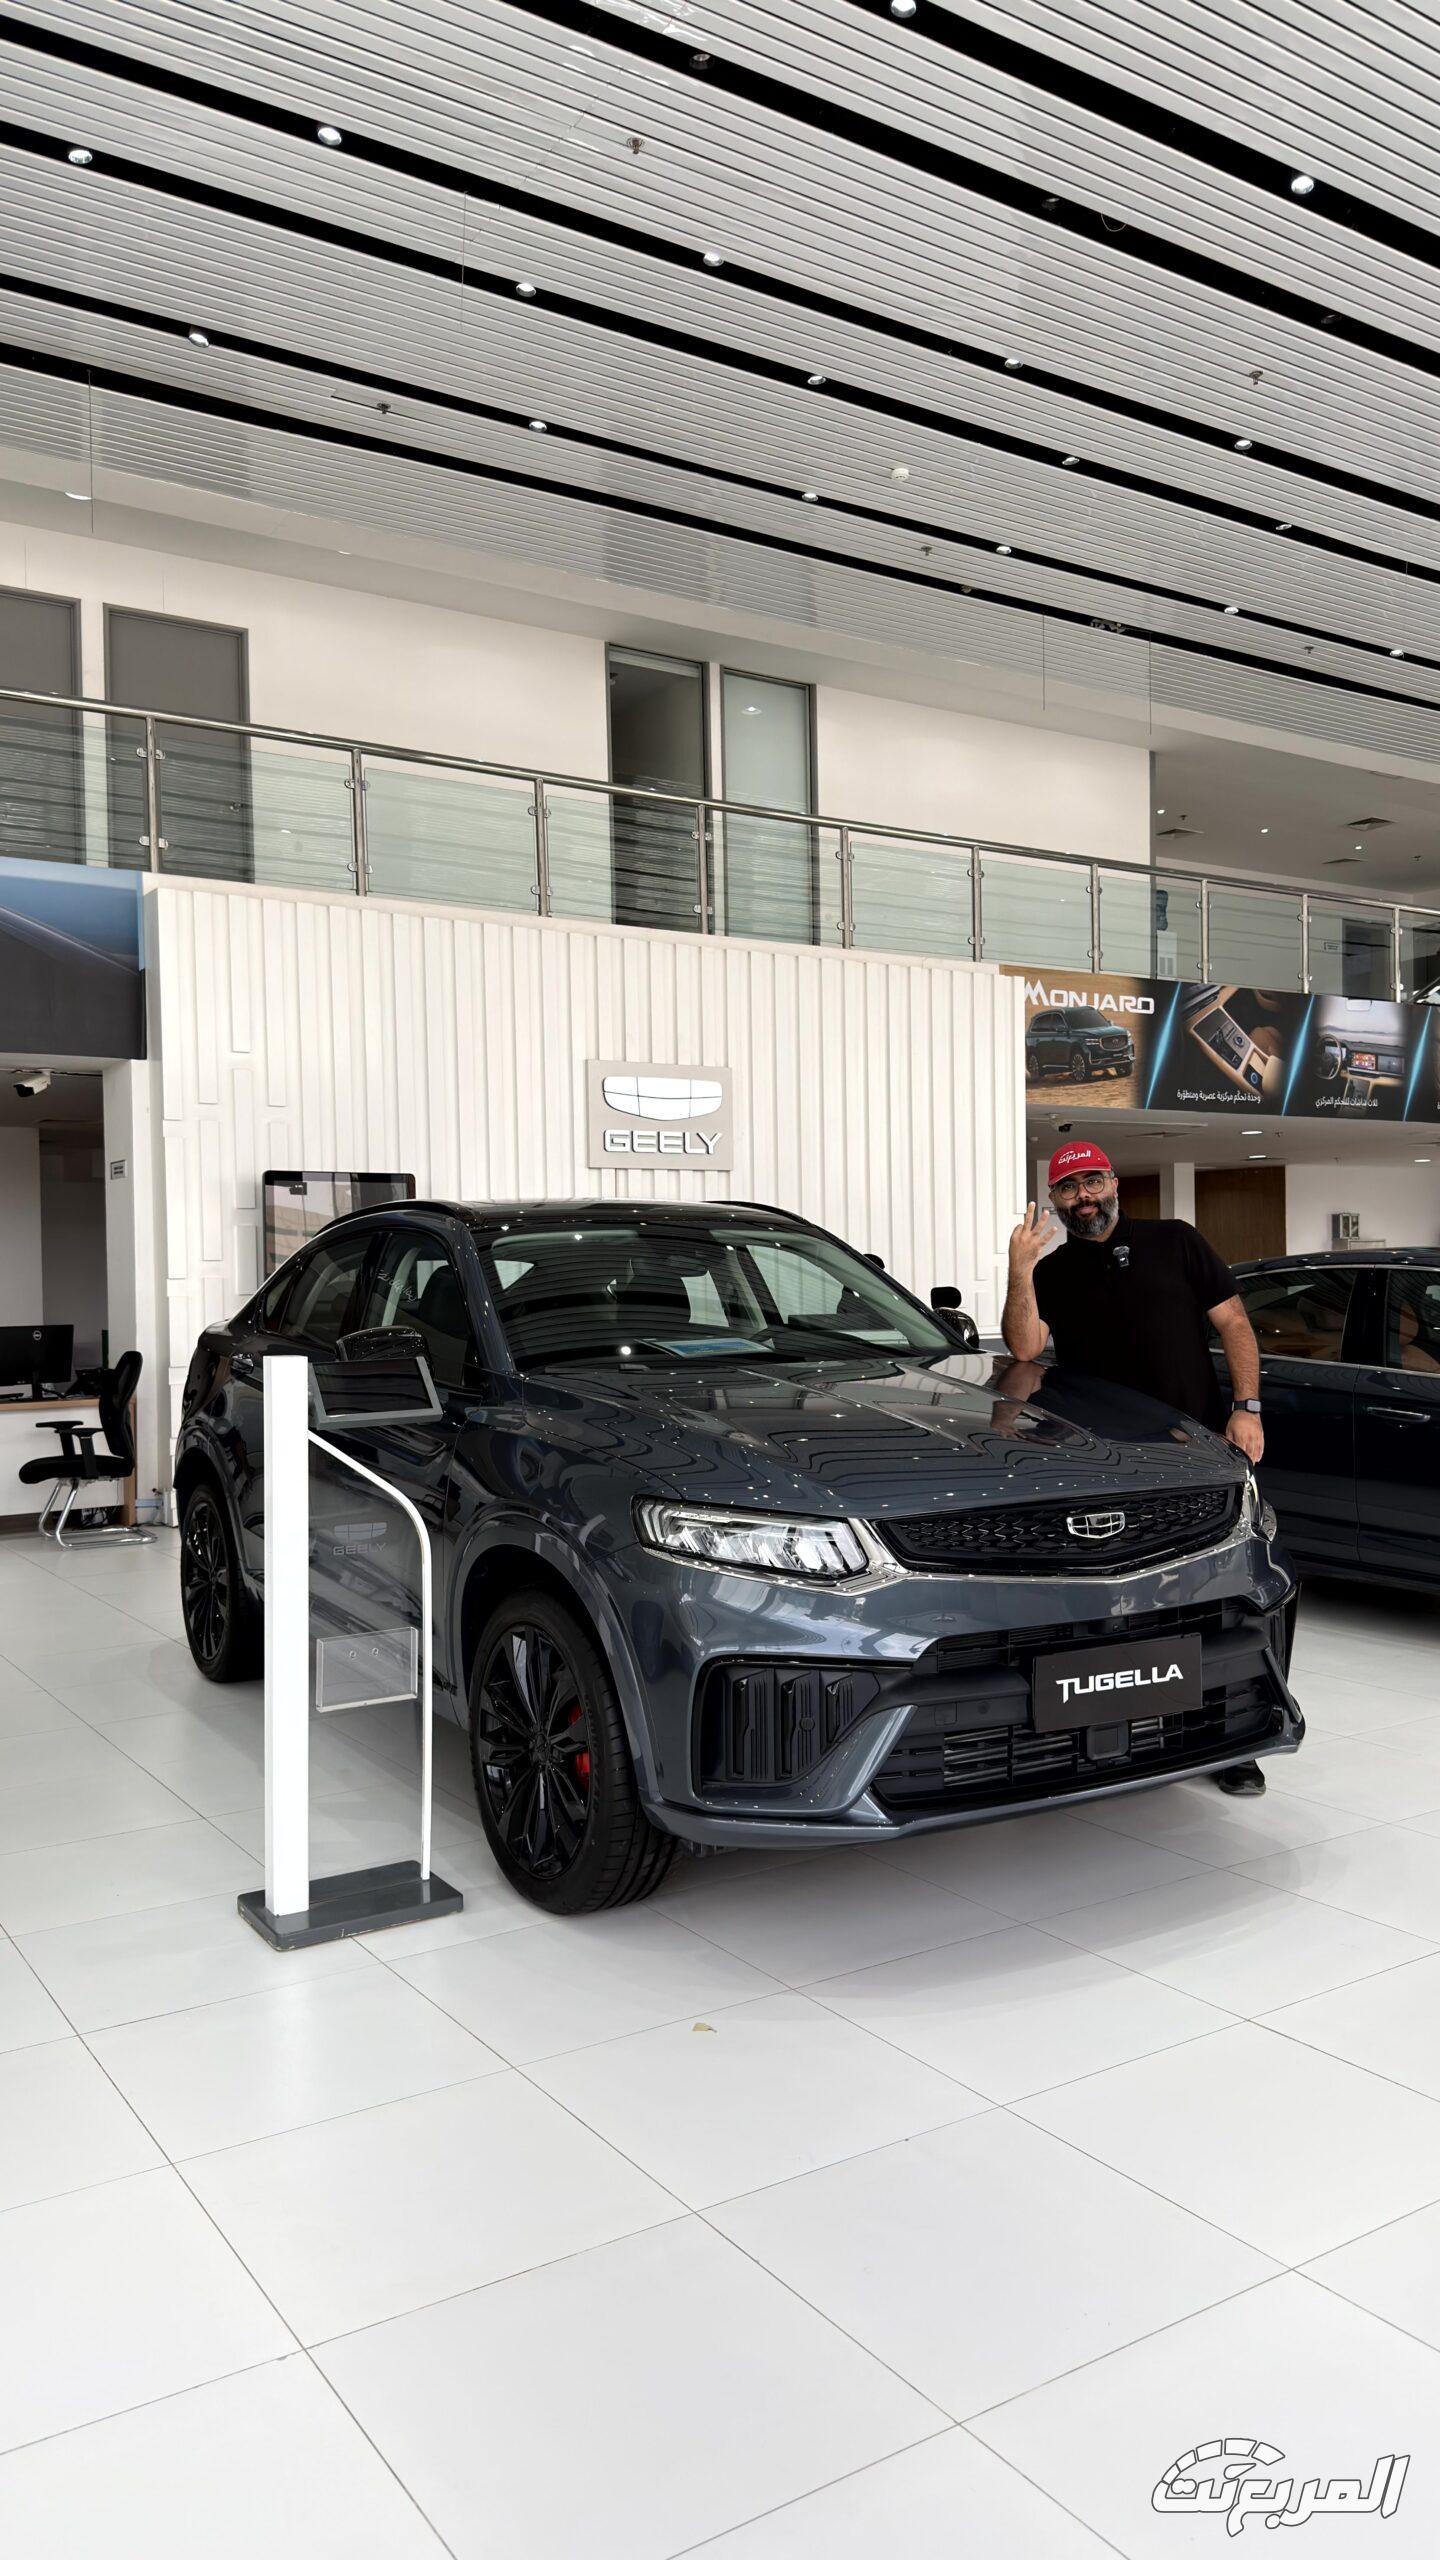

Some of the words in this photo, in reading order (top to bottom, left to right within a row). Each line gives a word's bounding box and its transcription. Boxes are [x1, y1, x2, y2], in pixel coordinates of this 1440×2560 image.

[1024, 979, 1155, 1015] MONJARO
[603, 1129, 722, 1154] GEELY
[333, 1543, 386, 1556] GEELY
[1055, 1663, 1184, 1704] TUGELLA
